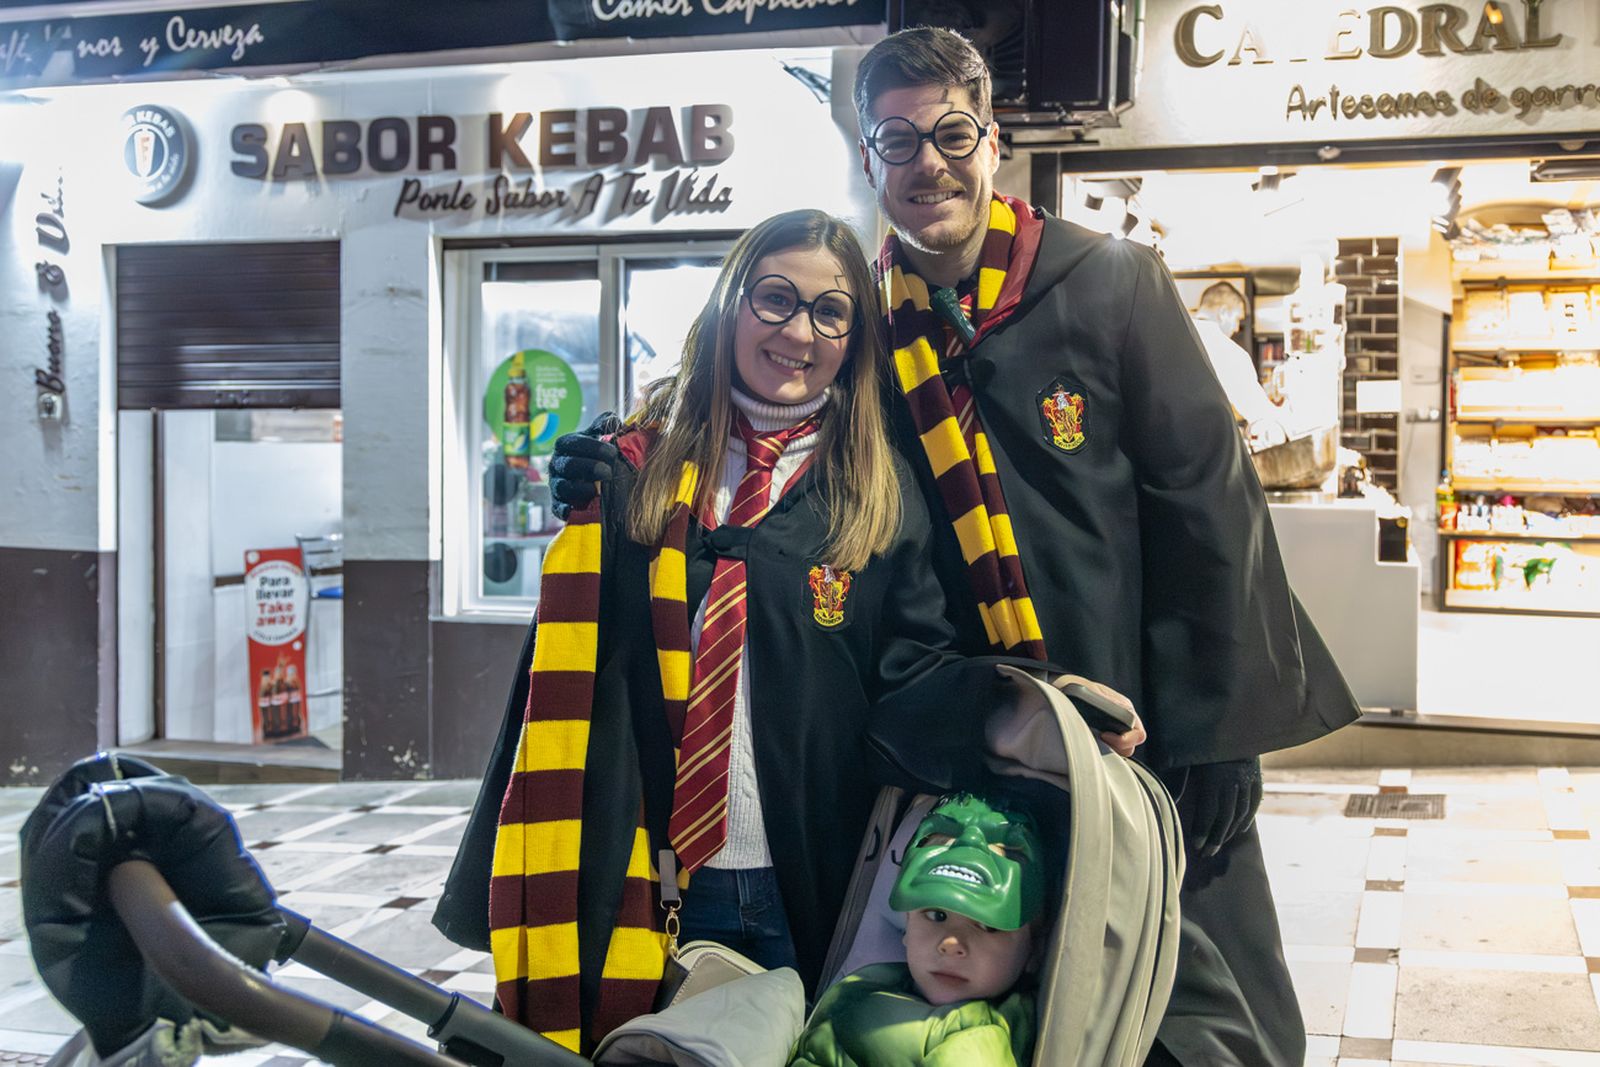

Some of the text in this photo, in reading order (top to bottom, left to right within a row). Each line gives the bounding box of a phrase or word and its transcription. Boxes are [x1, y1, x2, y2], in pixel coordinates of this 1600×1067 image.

[139, 36, 160, 67] y
[165, 16, 265, 61] Cerveza
[1173, 0, 1564, 68] CAEDRAL
[1461, 76, 1501, 110] de
[230, 115, 458, 179] SABOR
[488, 104, 735, 170] KEBAB
[393, 167, 733, 218] Ponle Sabor A Tu Vida
[260, 576, 291, 587] Para
[256, 614, 297, 627] away
[258, 602, 294, 614] Take
